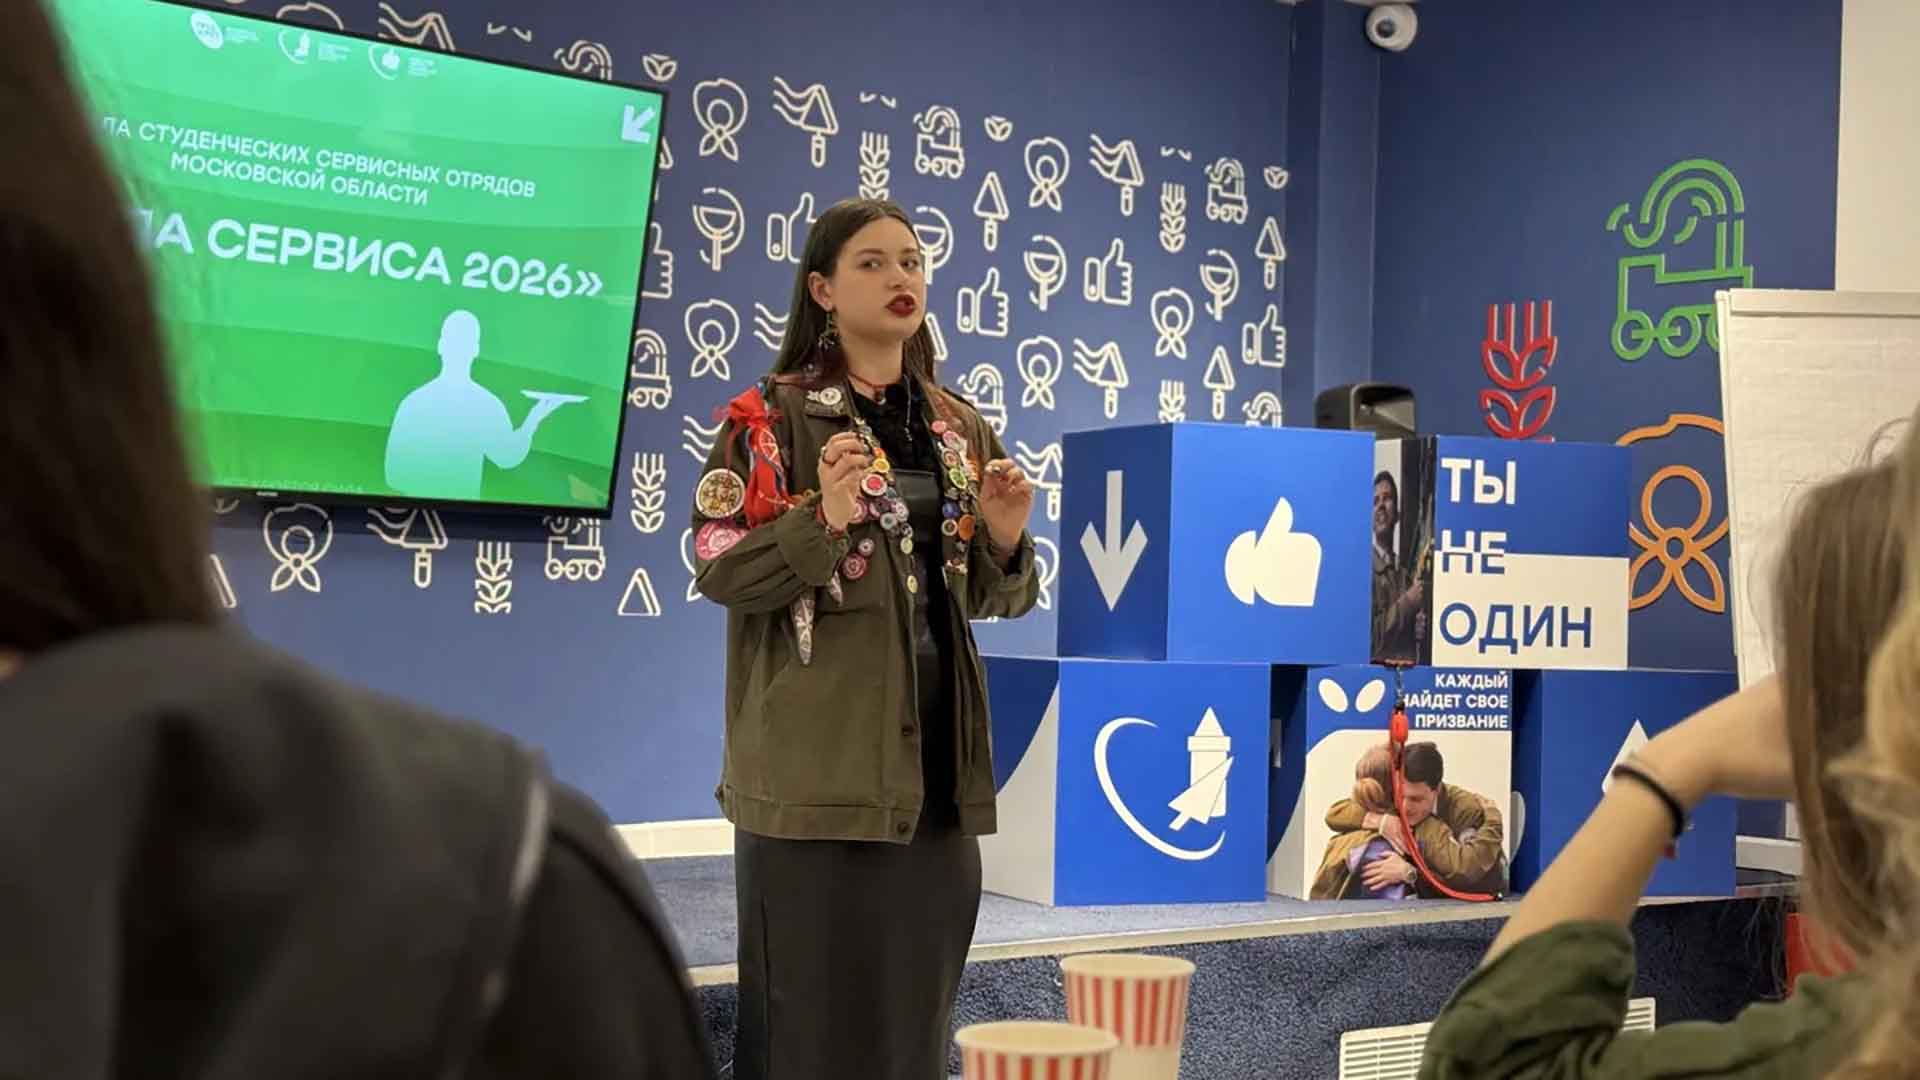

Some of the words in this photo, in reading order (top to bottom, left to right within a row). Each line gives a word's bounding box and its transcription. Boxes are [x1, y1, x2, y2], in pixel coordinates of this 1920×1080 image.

[138, 122, 311, 165] СТУДЕНЧЕСКИХ
[316, 149, 440, 184] СЕРВИСНЫХ
[445, 169, 536, 198] ОТРЯДОВ
[171, 152, 325, 191] МОСКОВСКОЙ
[331, 176, 429, 206] ОБЛАСТИ
[207, 218, 452, 286] СЕРВИСА
[461, 251, 603, 299] 2026»
[1440, 457, 1517, 505] ТЫ
[1441, 529, 1507, 575] НЕ
[1439, 602, 1592, 655] ОДИН
[1434, 670, 1509, 691] КАЖДЫЙ
[1465, 694, 1509, 709] СВОЕ
[1414, 713, 1509, 729] ПРИЗВАНИЕ
